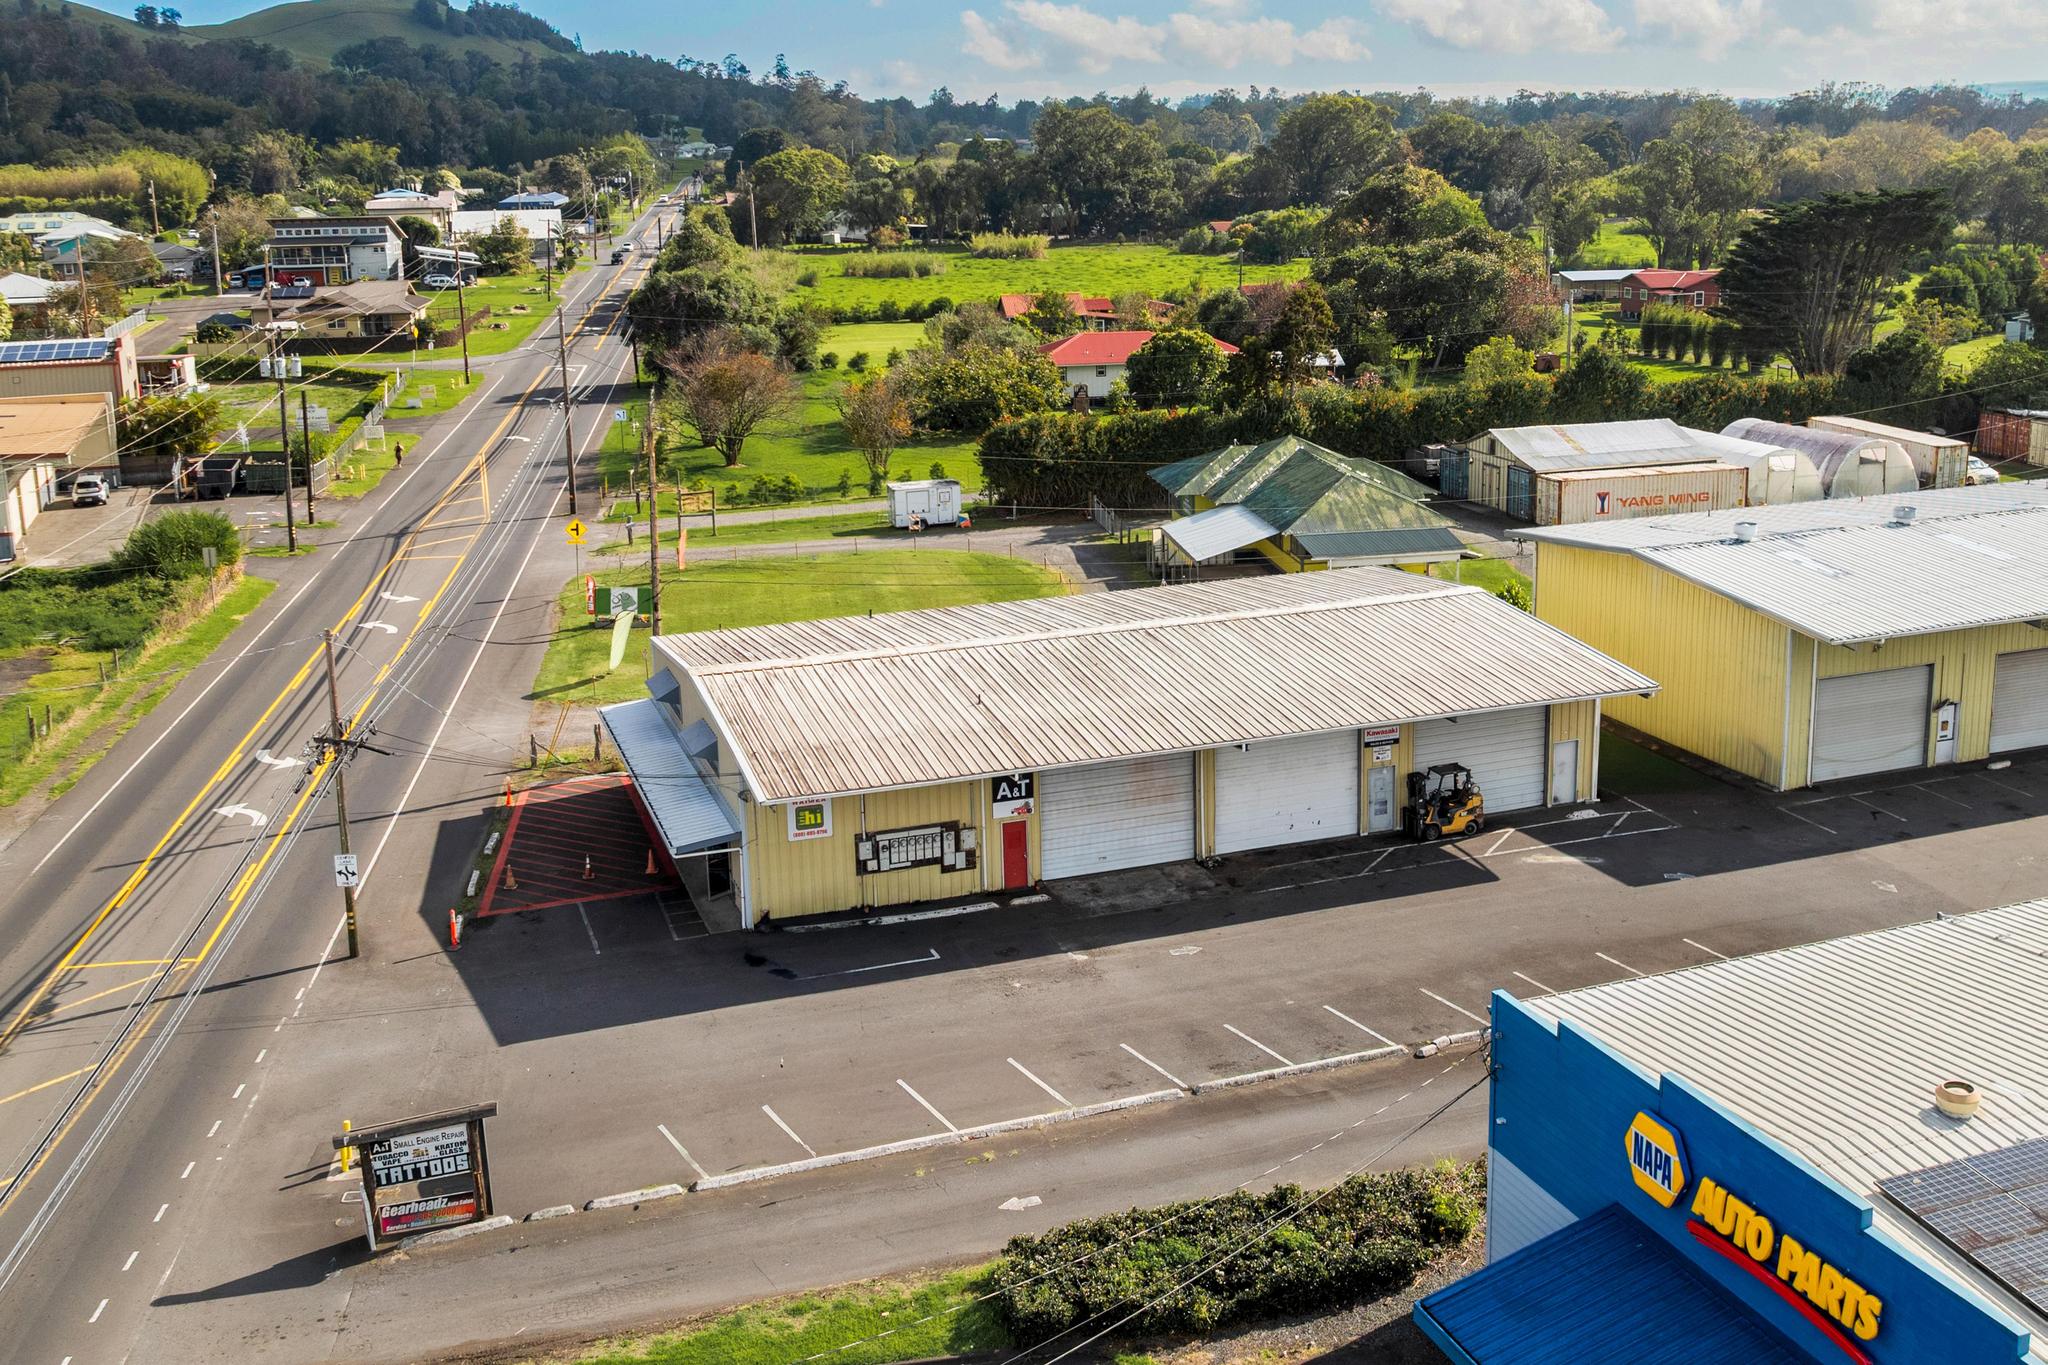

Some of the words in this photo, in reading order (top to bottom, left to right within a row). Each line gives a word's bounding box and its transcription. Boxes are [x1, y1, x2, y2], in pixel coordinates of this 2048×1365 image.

[1617, 496, 1664, 507] YANG
[1669, 492, 1710, 504] MING
[1366, 727, 1398, 736] Kawasaki
[997, 779, 1030, 800] A&T
[393, 1140, 415, 1149] SMALL
[416, 1136, 440, 1145] ENGINE
[441, 1131, 465, 1140] REPAIR
[434, 1140, 467, 1151] KRATOM
[373, 1150, 409, 1162] TOBACCO
[439, 1146, 464, 1156] GLASS
[382, 1159, 402, 1167] VAPE
[1632, 1130, 1672, 1191] NAPA
[376, 1154, 469, 1185] TATTOOS
[381, 1197, 449, 1218] Gearheadz
[1691, 1176, 1774, 1262] AUTO
[1776, 1234, 1882, 1341] PARTS
